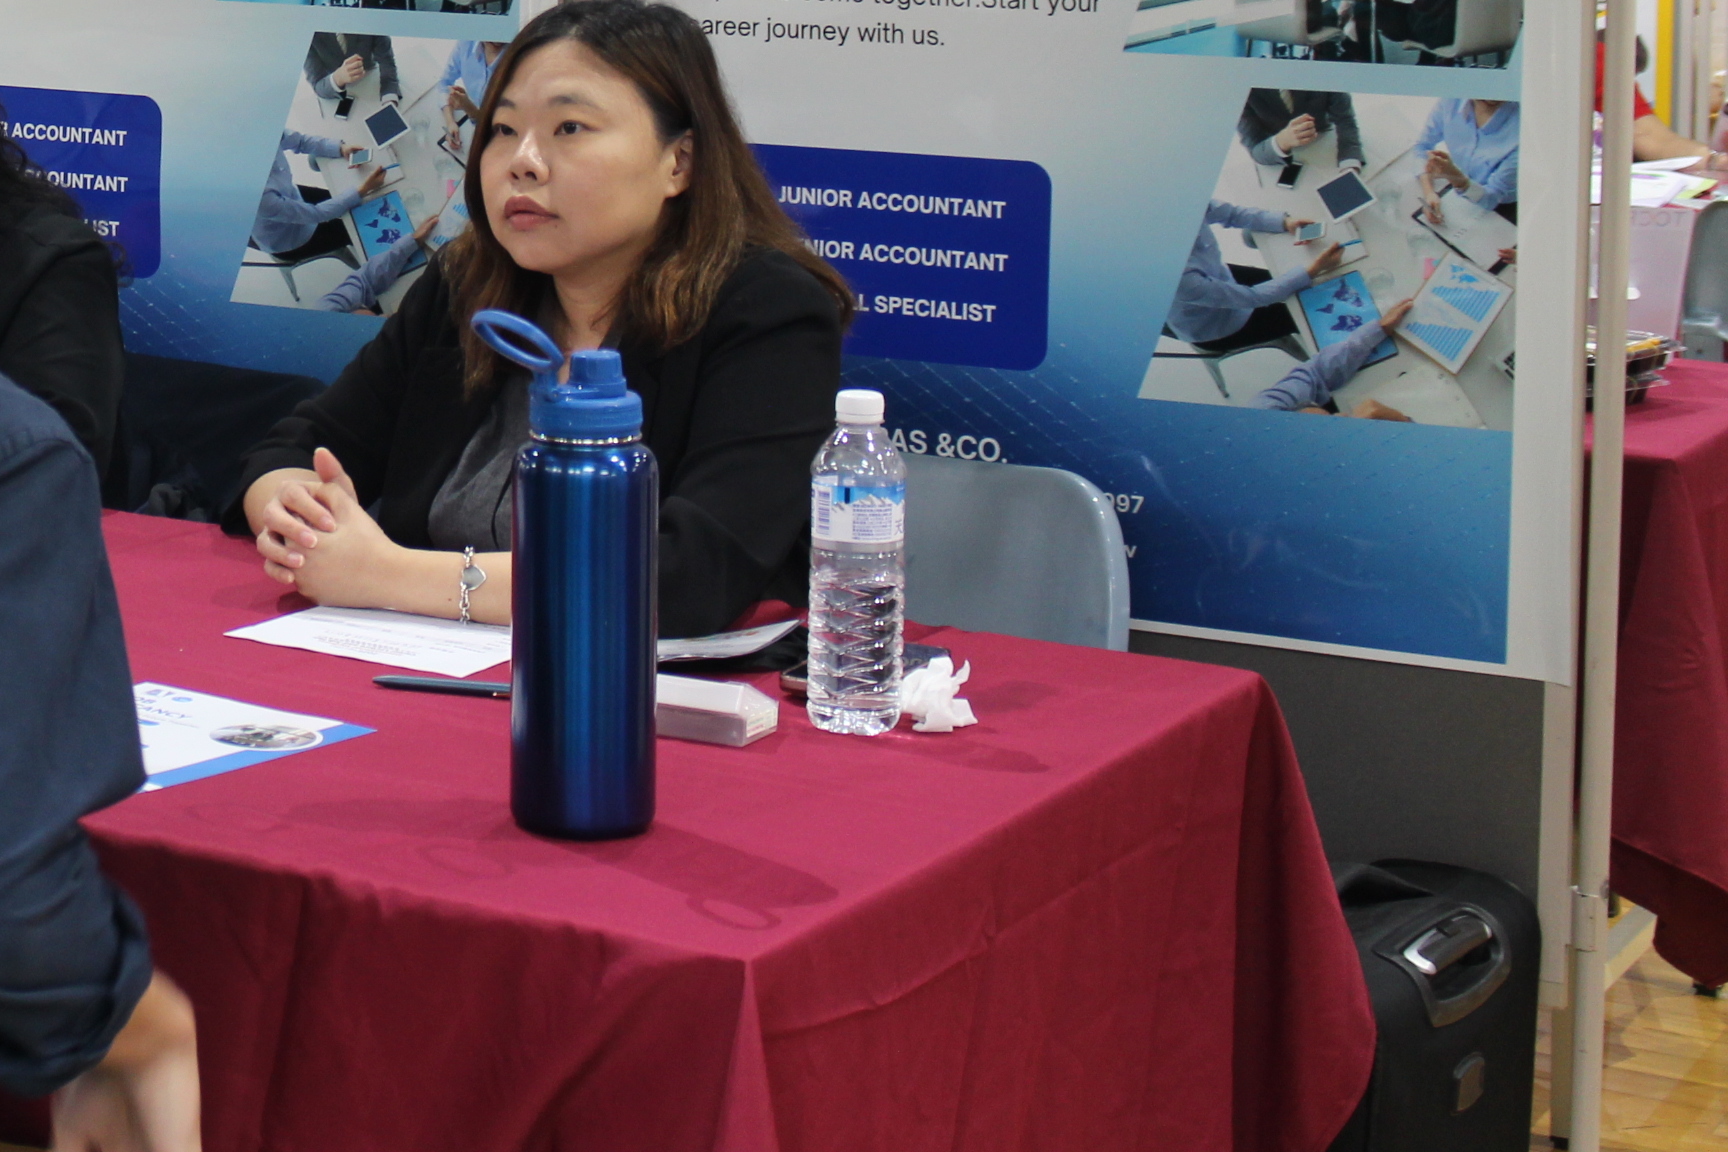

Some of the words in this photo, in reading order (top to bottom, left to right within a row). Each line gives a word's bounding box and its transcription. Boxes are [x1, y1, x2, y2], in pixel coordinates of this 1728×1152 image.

[700, 18, 760, 38] areer
[764, 18, 850, 46] journey
[857, 20, 904, 44] with
[912, 28, 945, 46] us.
[11, 122, 127, 146] ACCOUNTANT
[778, 185, 852, 208] JUNIOR
[857, 191, 1006, 219] ACCOUNTANT
[801, 238, 854, 260] NIOR
[859, 243, 1009, 272] ACCOUNTANT
[874, 295, 996, 323] SPECIALIST
[892, 428, 928, 454] AS
[935, 432, 1008, 464] &CO.
